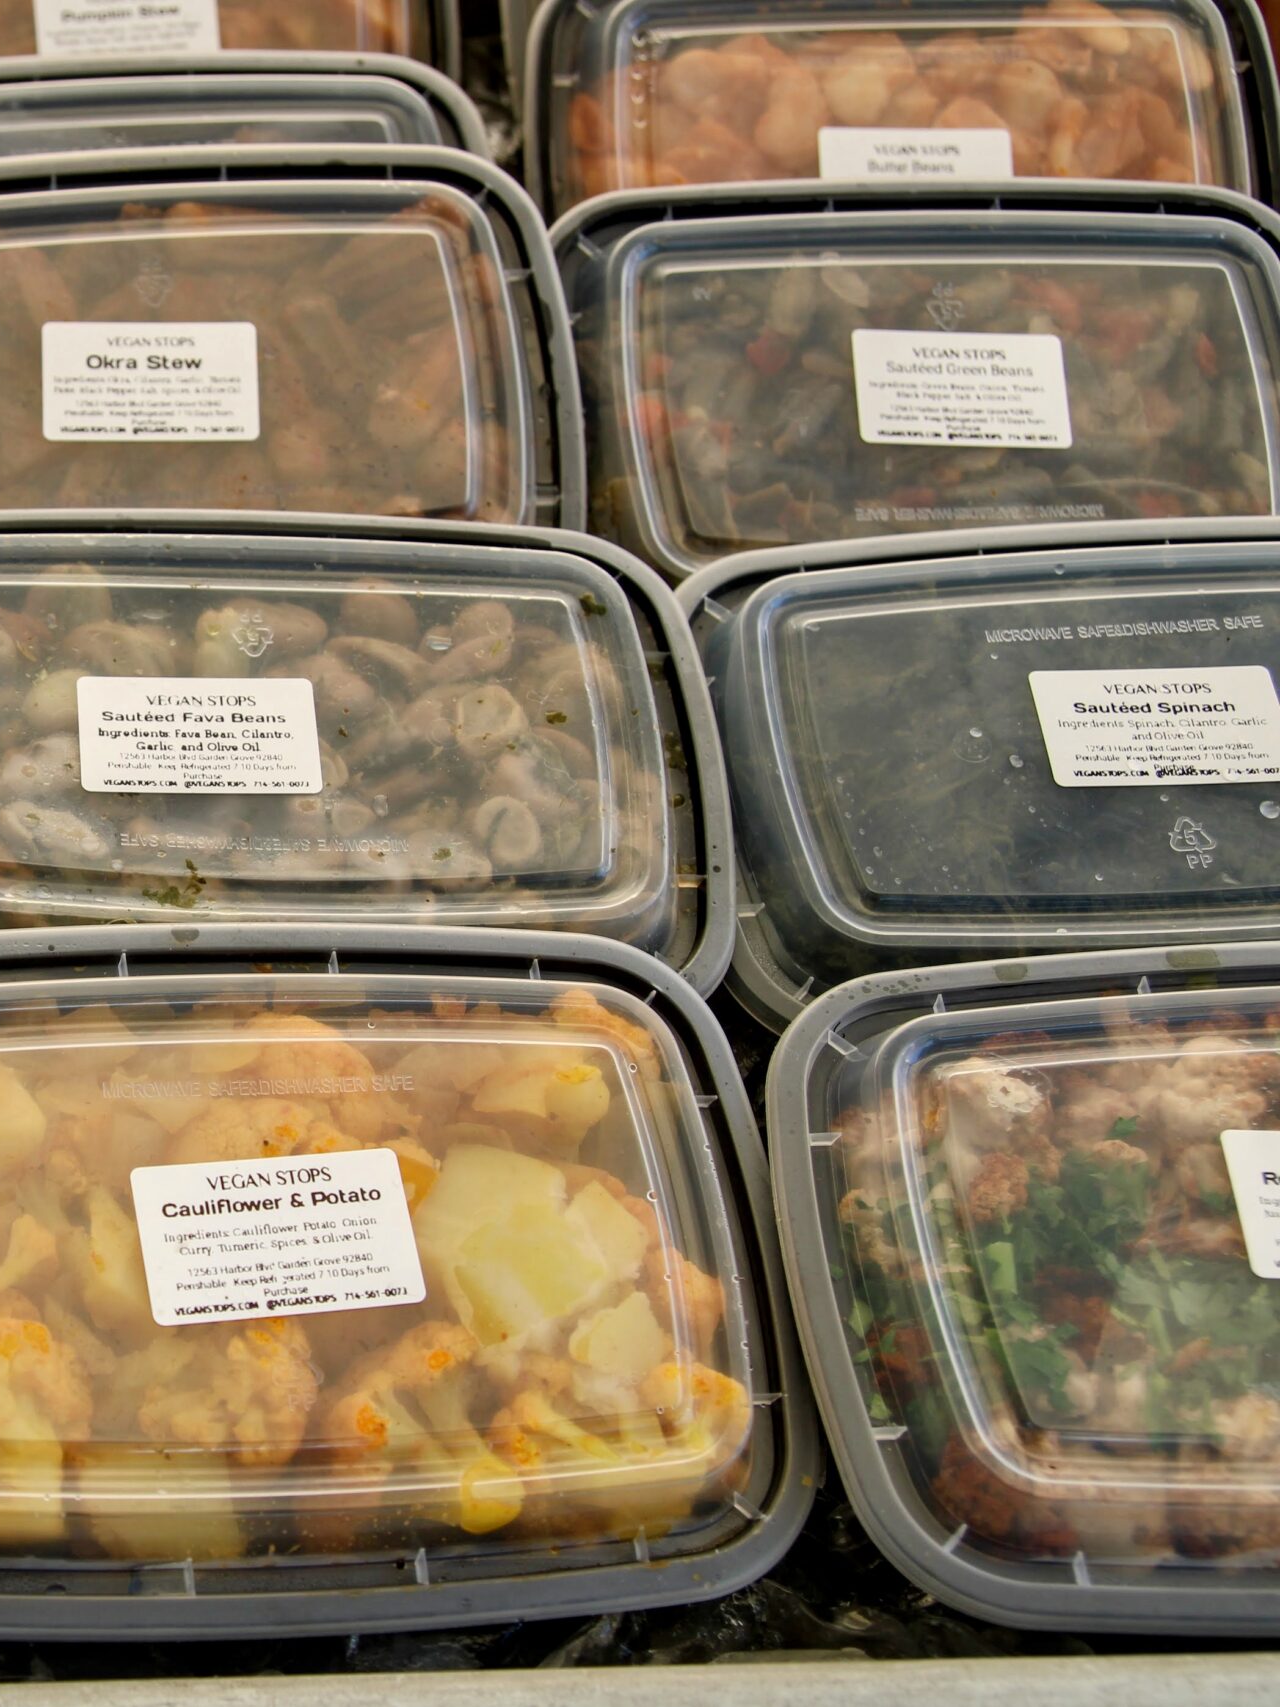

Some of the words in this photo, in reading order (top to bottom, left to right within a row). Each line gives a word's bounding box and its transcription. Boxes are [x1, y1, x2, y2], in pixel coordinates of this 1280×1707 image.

[867, 160, 908, 173] Butter
[912, 161, 955, 174] Beans
[107, 337, 151, 347] VEGAN
[155, 337, 195, 347] STOPS
[912, 347, 959, 360] VEGAN
[963, 349, 1007, 361] STOPS
[86, 354, 138, 370] Okra
[147, 354, 202, 370] Stew
[946, 363, 986, 377] Green
[990, 365, 1034, 378] Beans
[985, 626, 1073, 643] MICROWAVE
[1077, 618, 1220, 640] SAFE&DISHWASHER
[1223, 615, 1264, 630] SAFE
[1103, 684, 1157, 695] VEGAN
[1162, 683, 1212, 694] STOPS
[146, 695, 203, 706] VEGAN
[207, 695, 257, 707] STOPS
[1073, 702, 1151, 713] Sautéed
[1157, 702, 1236, 715] Spinach
[102, 711, 175, 722] Sautéed
[183, 712, 225, 723] Fava
[231, 712, 286, 723] Beans
[175, 729, 201, 738] Fava
[1132, 732, 1152, 741] and
[1154, 731, 1184, 740] Olive
[1186, 731, 1205, 740] Oil
[136, 741, 174, 751] Garlic
[181, 742, 203, 751] and
[207, 742, 238, 752] Olive
[1186, 853, 1213, 869] PP
[102, 1080, 202, 1099] MICROWAVE
[207, 1077, 367, 1097] SAFE&DISHWASHER
[371, 1075, 415, 1092] SAFE
[206, 1172, 272, 1191] VEGAN
[276, 1166, 333, 1186] STOPS
[161, 1197, 283, 1219] Cauliflower
[290, 1192, 305, 1208] &
[312, 1187, 381, 1207] Potato
[322, 1232, 352, 1244] Olive
[188, 1266, 218, 1277] 12563
[220, 1264, 253, 1275] Harbor
[277, 1259, 311, 1270] Garden
[314, 1257, 341, 1267] Grove
[342, 1252, 373, 1264] 92840
[176, 1280, 227, 1291] Perishable
[233, 1278, 258, 1287] Keep
[340, 1267, 365, 1278] Days
[367, 1264, 390, 1275] from
[264, 1287, 309, 1298] Purchase
[345, 1287, 408, 1300] 714-561-0073
